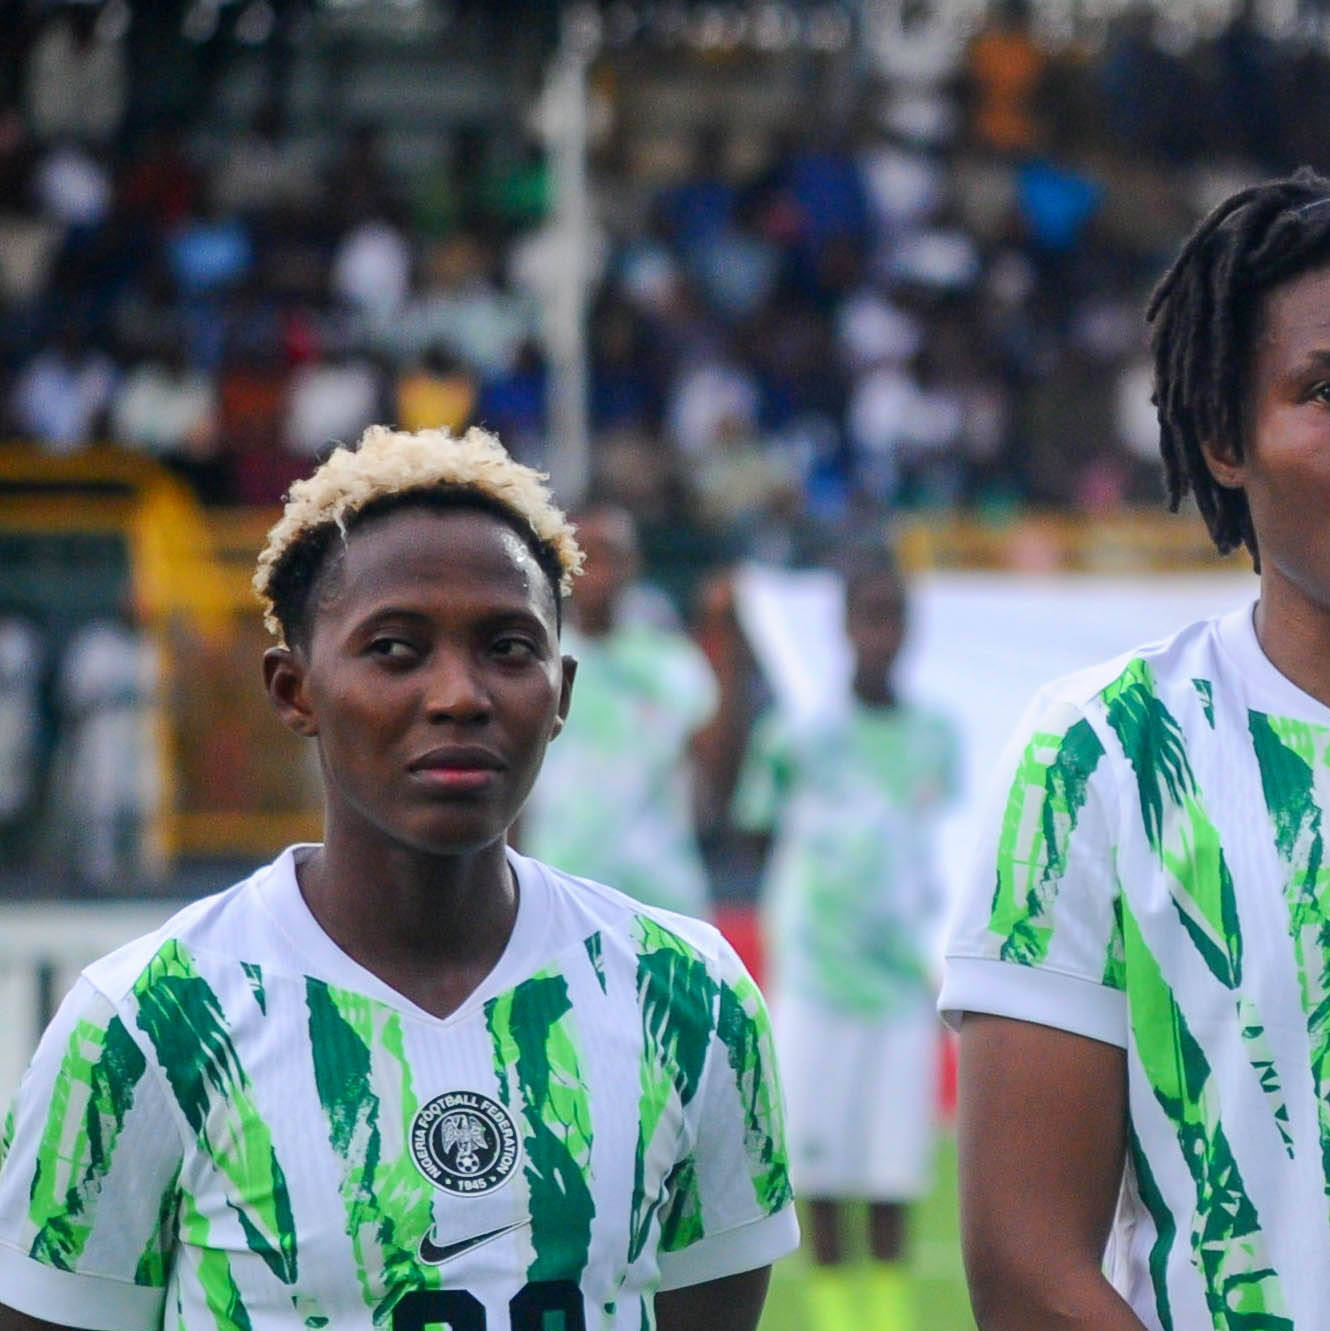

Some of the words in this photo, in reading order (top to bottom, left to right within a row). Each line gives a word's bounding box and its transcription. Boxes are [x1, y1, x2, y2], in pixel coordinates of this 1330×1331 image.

[419, 1095, 479, 1128] FOOTBALL
[415, 1130, 441, 1178] NIGERIA
[481, 1101, 515, 1174] FEDERATION
[458, 1178, 487, 1190] 1945
